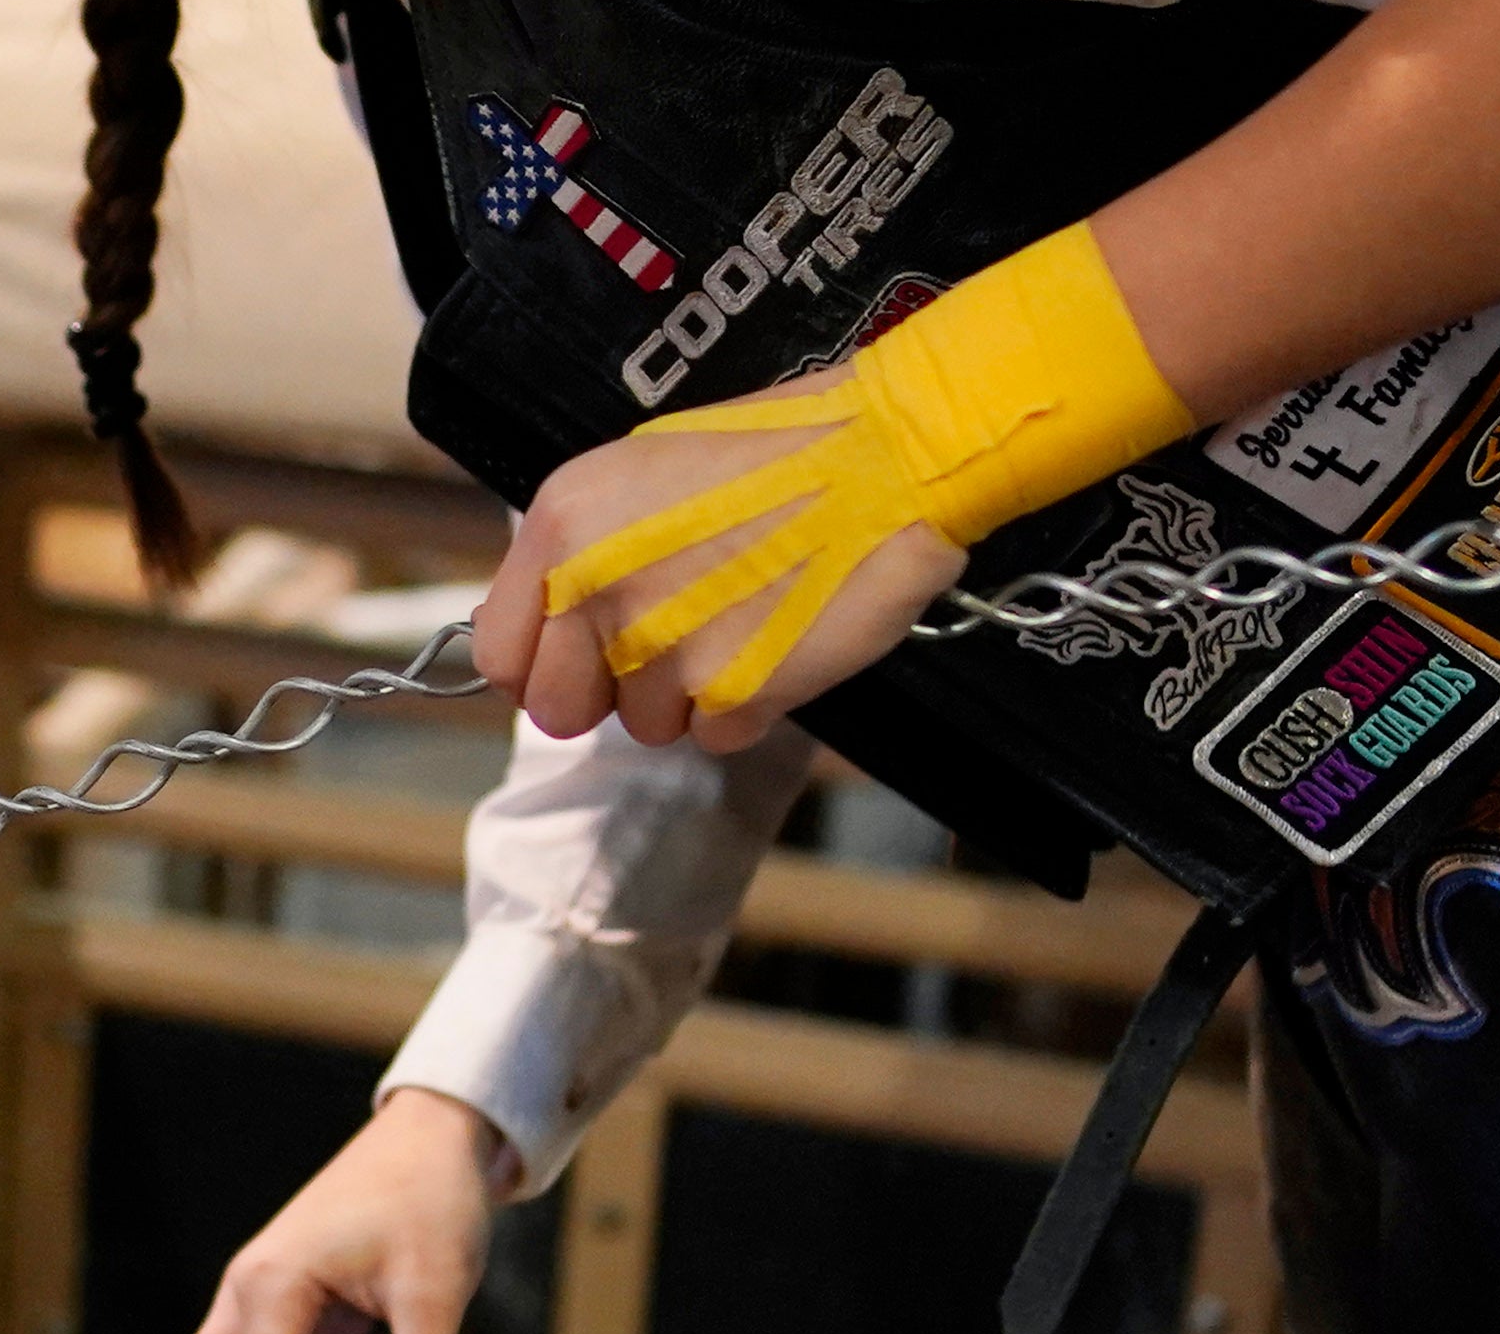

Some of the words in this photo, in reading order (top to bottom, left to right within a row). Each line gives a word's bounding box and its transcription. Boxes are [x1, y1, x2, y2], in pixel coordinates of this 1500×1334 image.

[622, 67, 927, 409] COOPER
[782, 104, 954, 297] TIRES
[1250, 697, 1346, 780] CUSH
[1324, 616, 1428, 711] SHIN
[1280, 747, 1378, 833] SOCK
[1349, 653, 1478, 769] GUARDS
